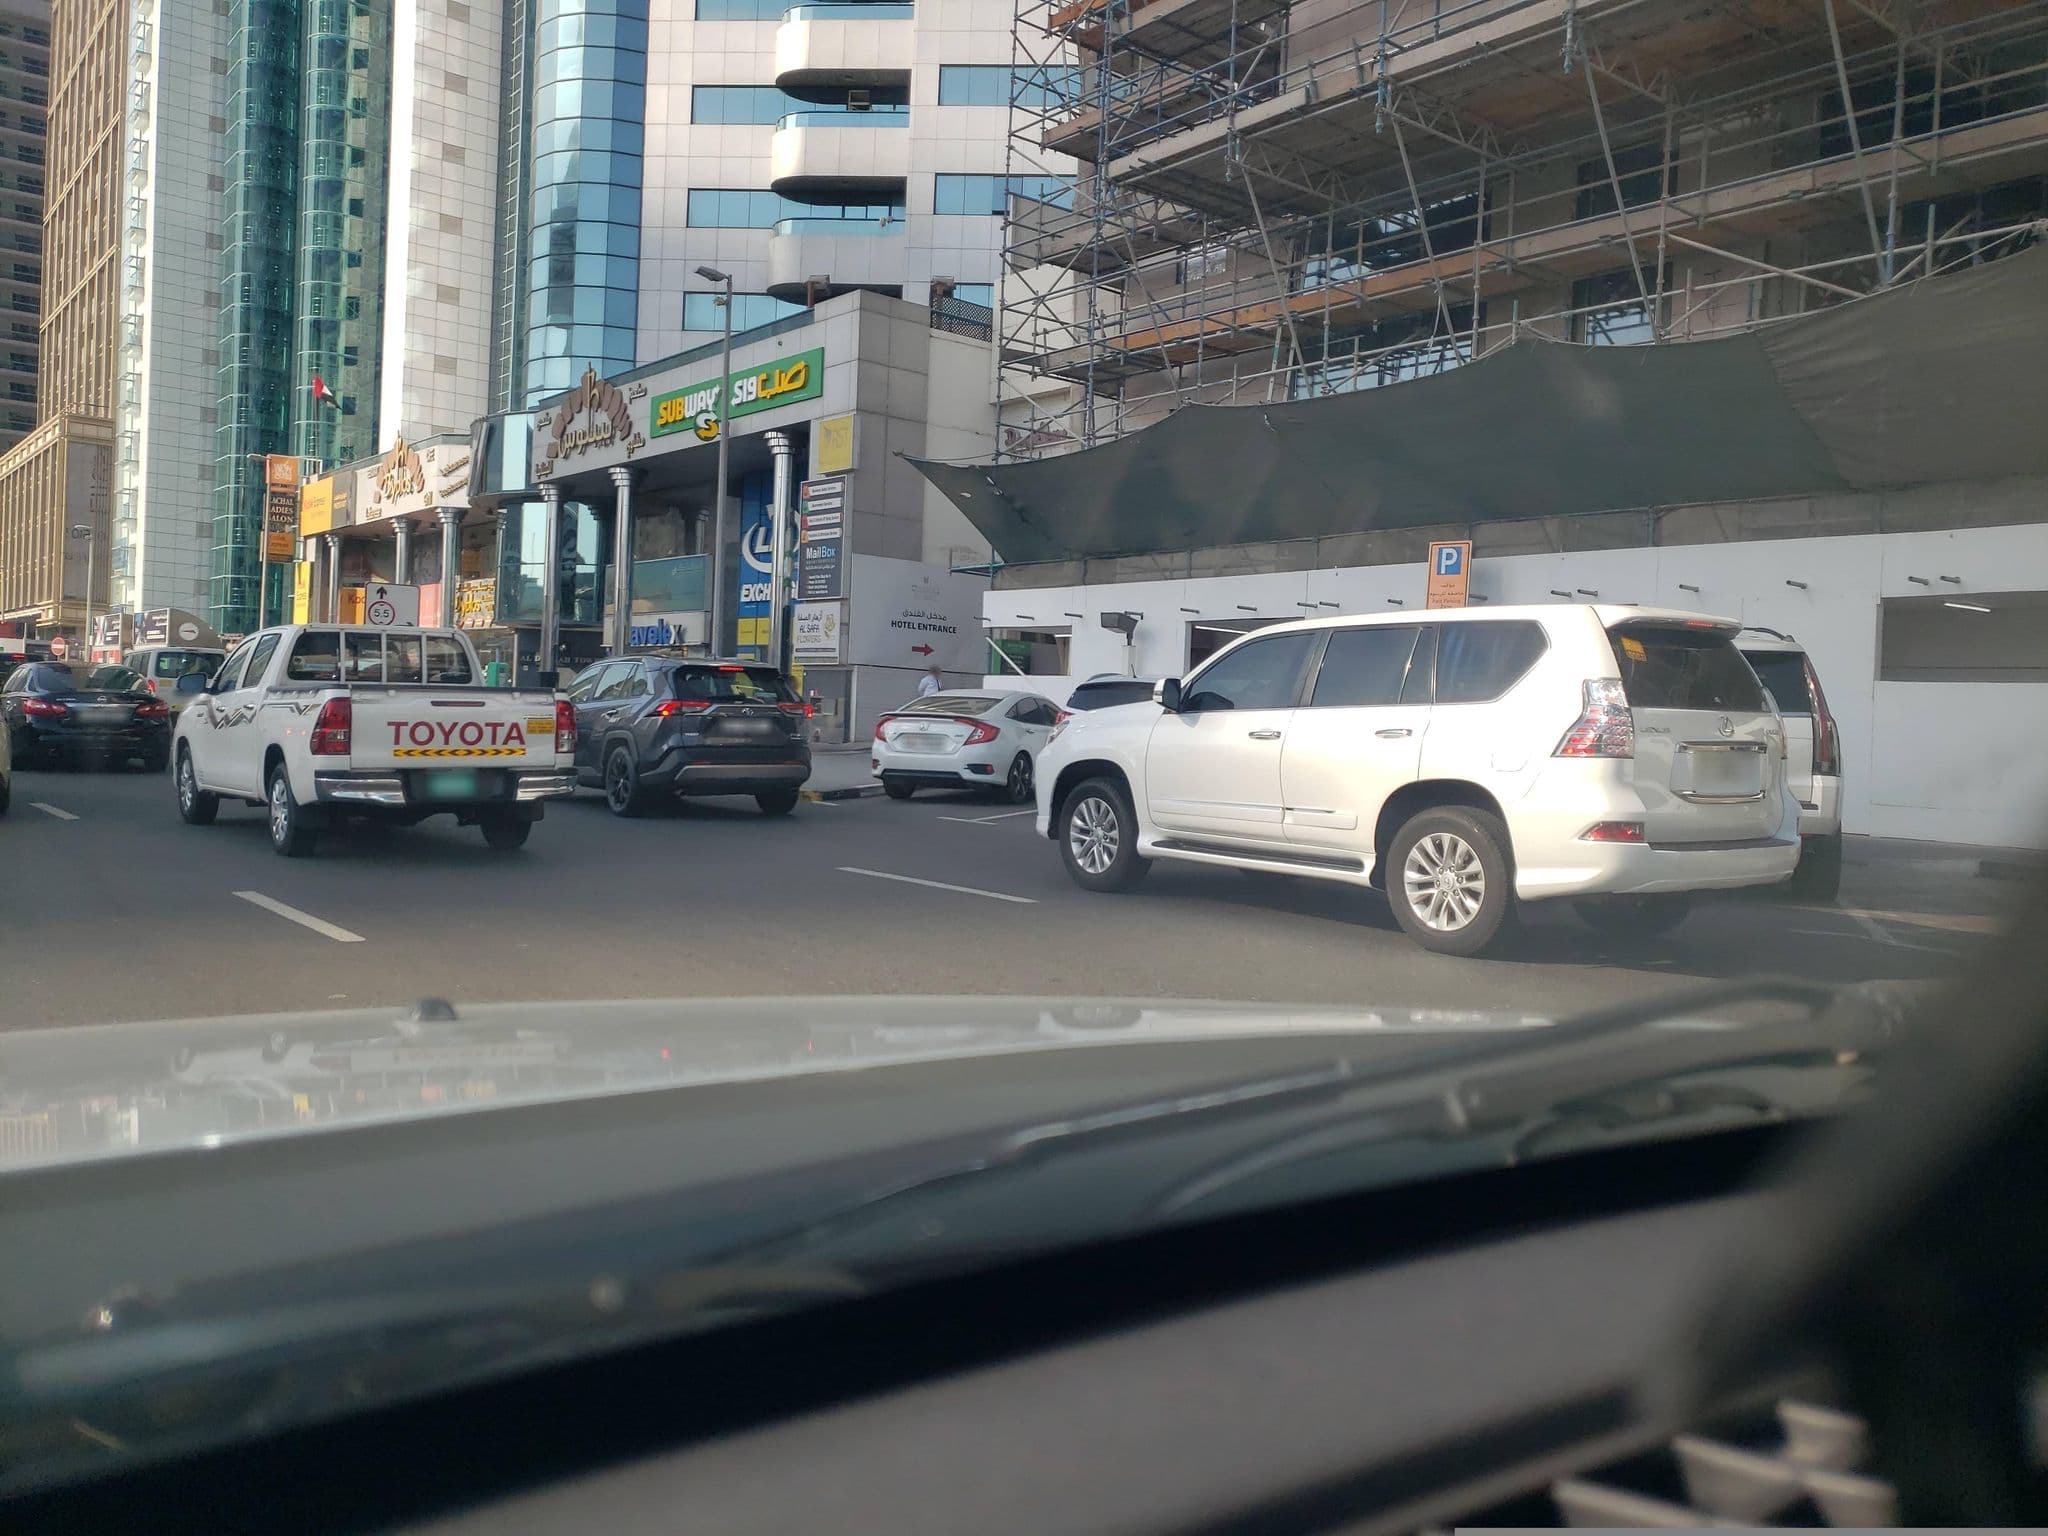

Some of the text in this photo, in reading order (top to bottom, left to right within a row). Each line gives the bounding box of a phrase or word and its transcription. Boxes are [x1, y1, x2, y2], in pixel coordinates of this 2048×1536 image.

[657, 384, 721, 426] SUBWAY
[269, 497, 294, 506] ACHAL
[269, 506, 294, 514] ADIES
[269, 515, 293, 523] ALON
[806, 545, 836, 559] MailBox
[1440, 548, 1457, 574] P
[373, 608, 390, 618] 5.5
[903, 609, 947, 621] مدخل الفندق
[630, 619, 684, 646] avelex
[891, 620, 957, 634] HOTEL ENTRANCE
[387, 721, 526, 746] TOYOTA
